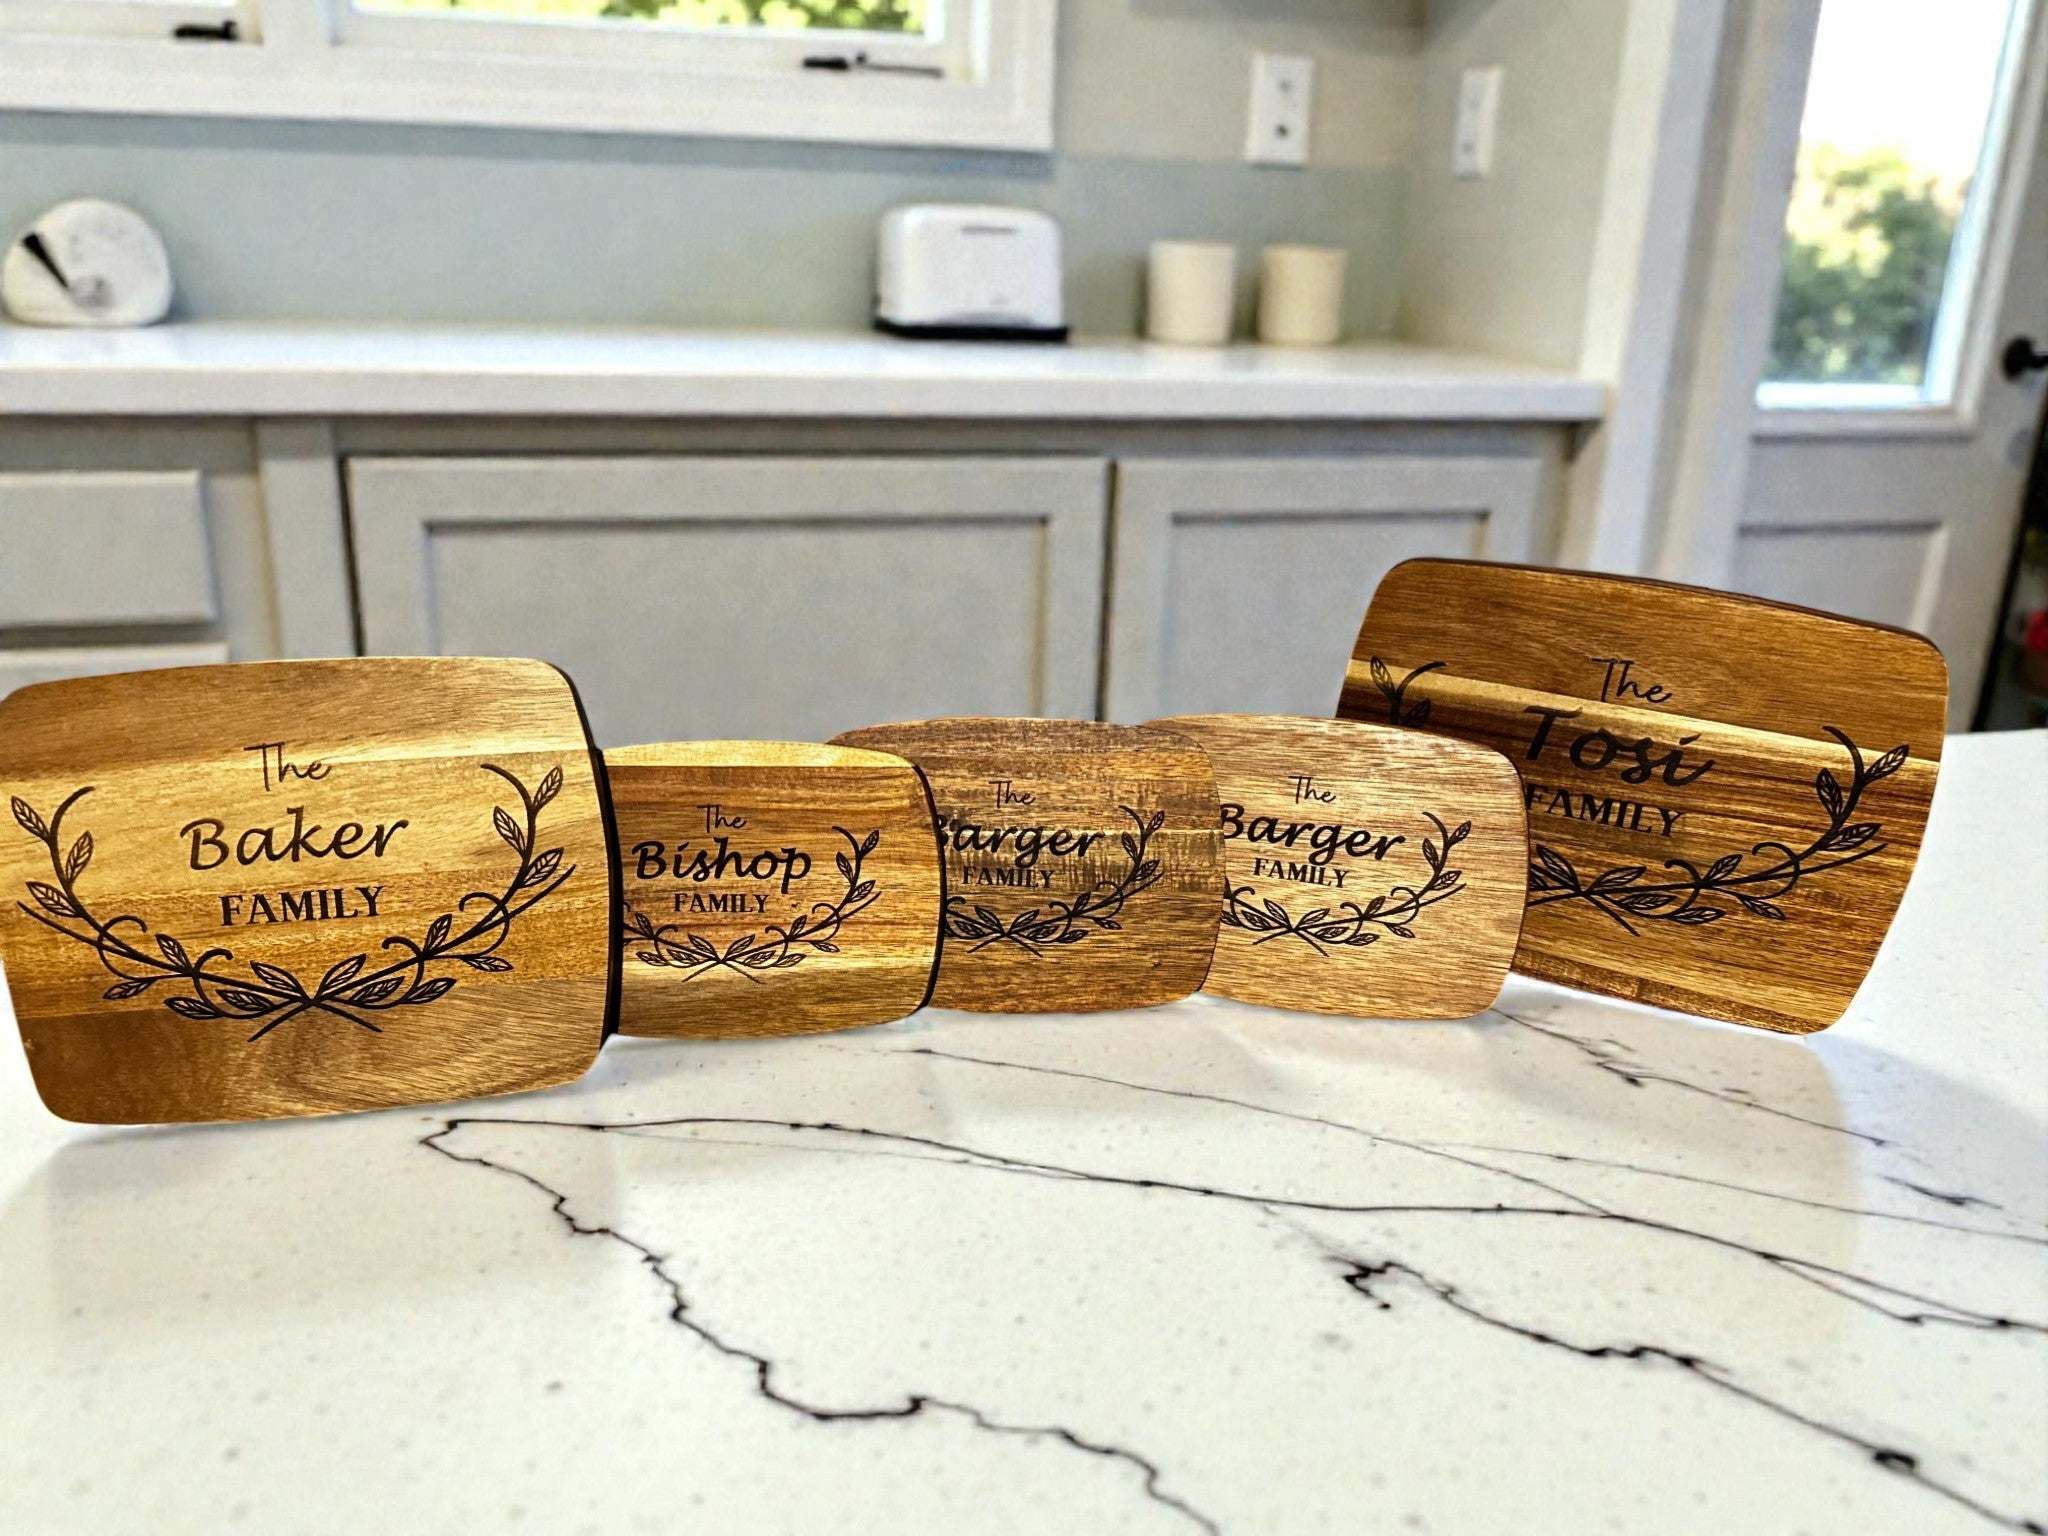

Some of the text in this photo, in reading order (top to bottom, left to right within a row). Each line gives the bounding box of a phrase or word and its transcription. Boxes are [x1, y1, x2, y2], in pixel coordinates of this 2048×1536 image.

[1591, 656, 1673, 704] The
[243, 741, 332, 793] The
[1523, 704, 1716, 787] Tosi
[988, 779, 1037, 809] The
[1287, 775, 1337, 805] The
[1524, 782, 1688, 838] FAMILY
[180, 806, 410, 871] Baker
[696, 803, 748, 834] The
[1220, 803, 1406, 866] Barger
[631, 836, 812, 895] Bishop
[962, 865, 1054, 889] FAMILY
[1253, 857, 1350, 889] FAMILY
[219, 884, 385, 928] FAMILY
[673, 892, 770, 914] FAMILY
